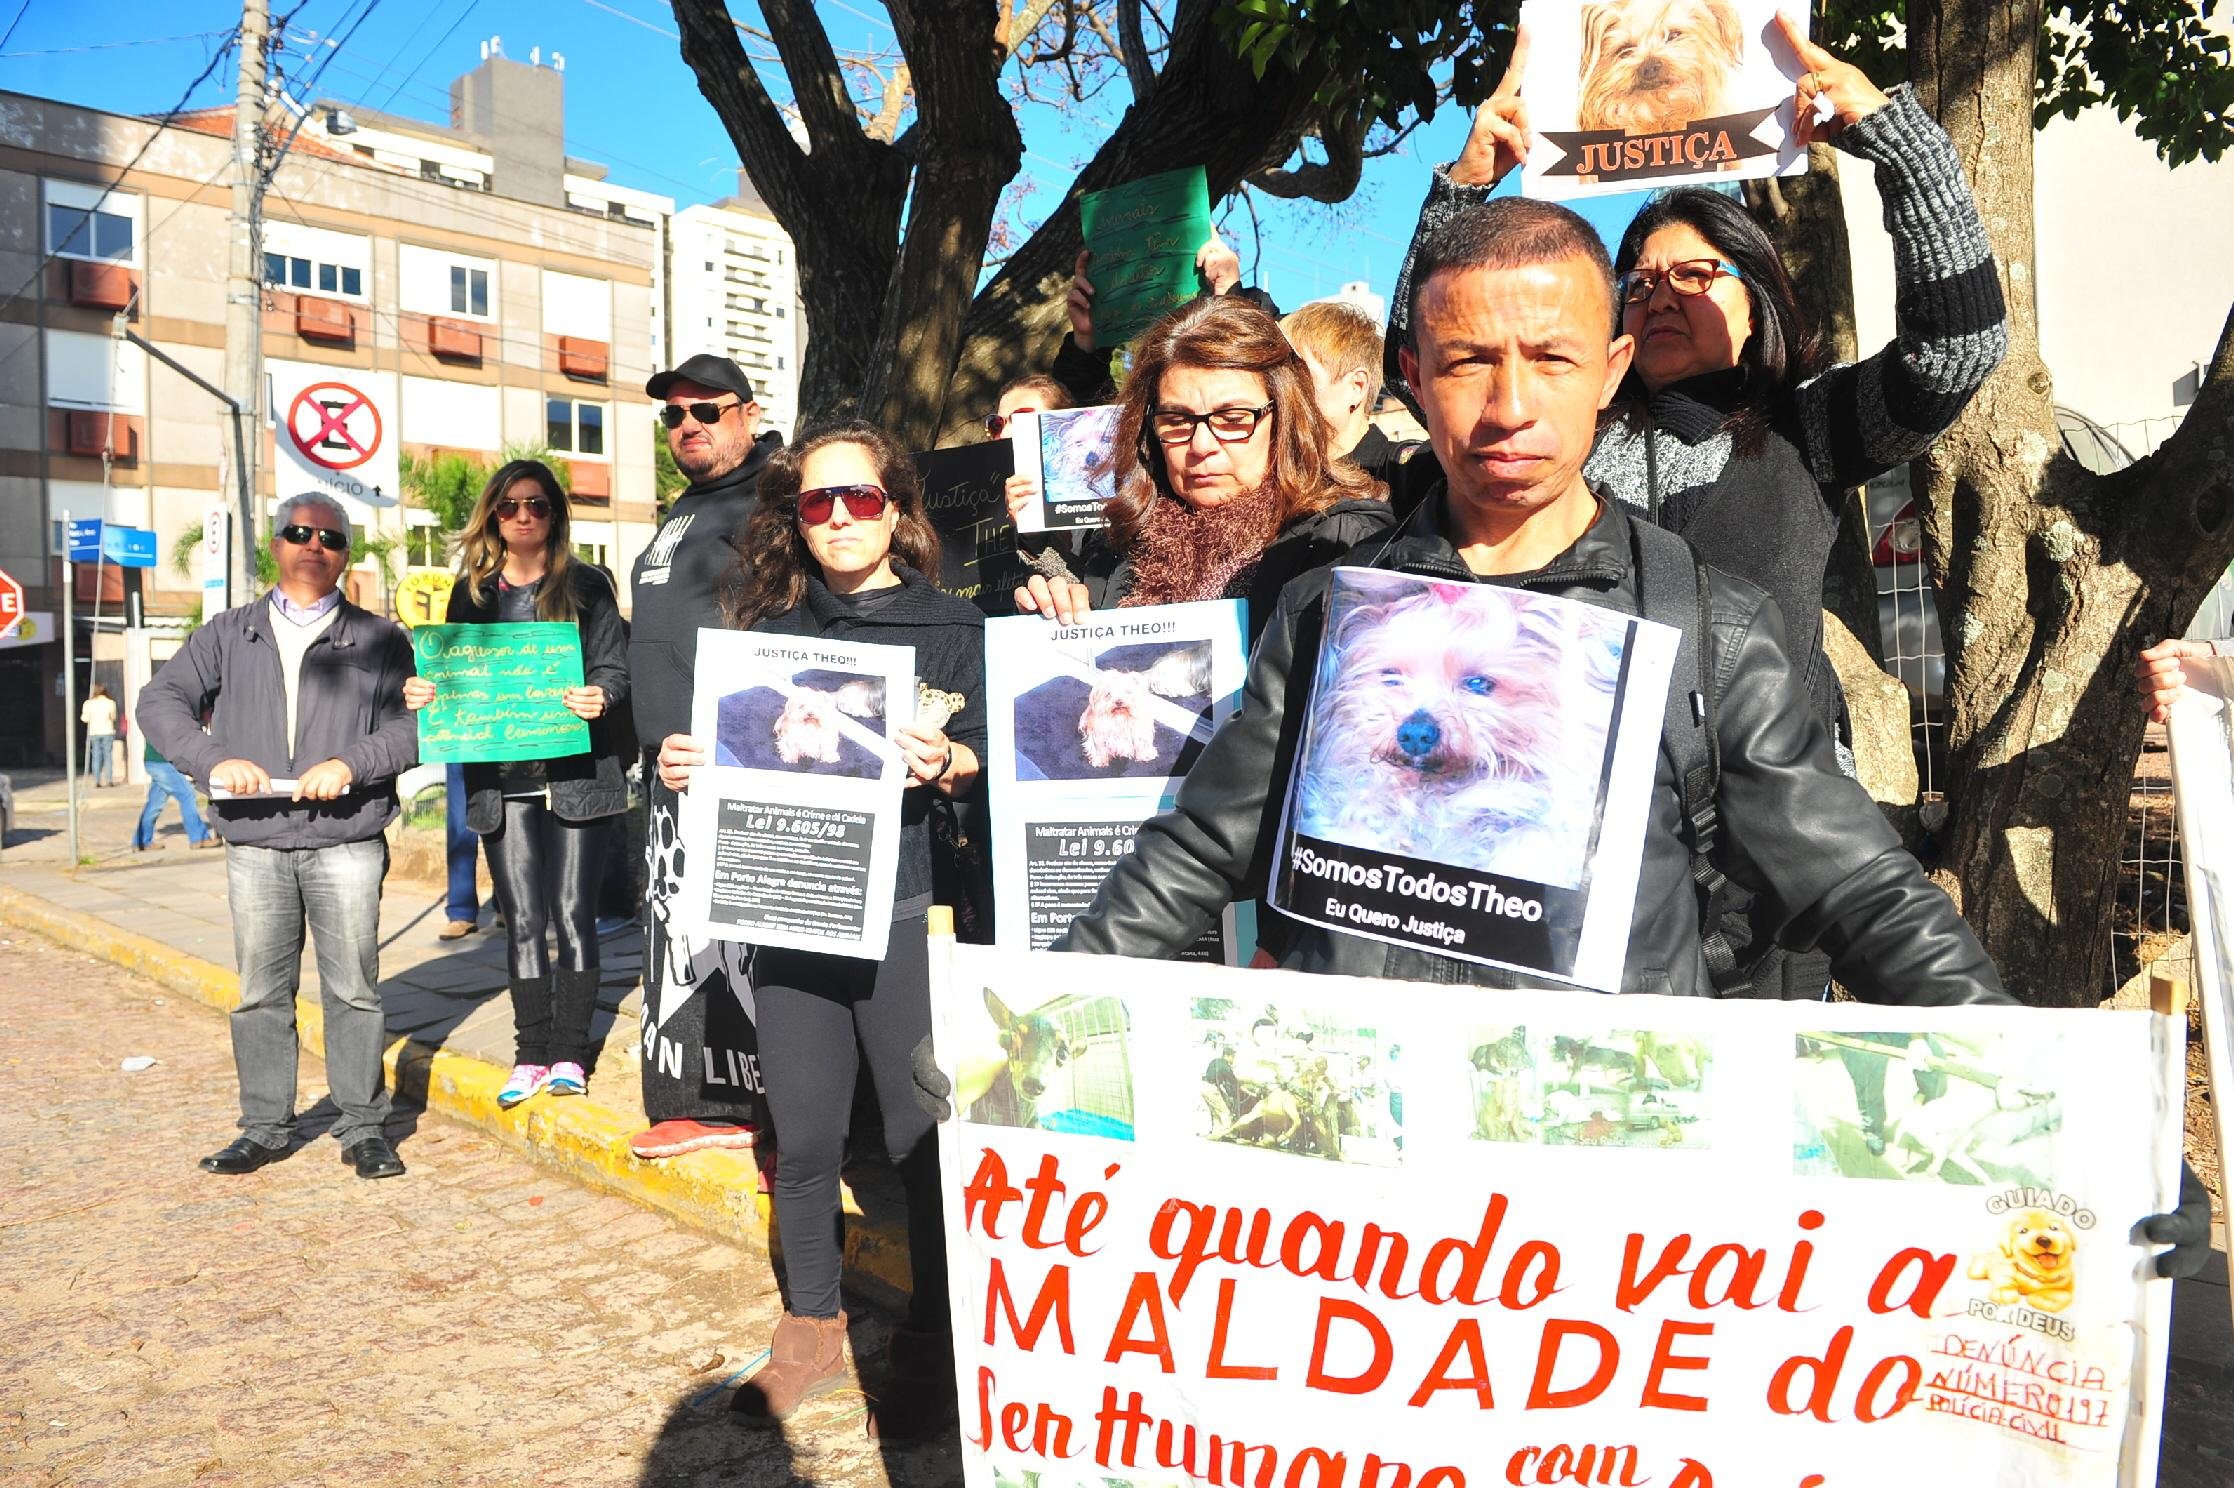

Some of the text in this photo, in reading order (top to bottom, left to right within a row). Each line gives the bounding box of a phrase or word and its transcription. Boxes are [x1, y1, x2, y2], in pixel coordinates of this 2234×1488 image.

[1576, 131, 1737, 173] JUSTIÇA
[419, 630, 443, 660] O
[1051, 621, 1176, 641] JUSTIÇA THEO!!!
[754, 647, 857, 666] JUSTIÇA THEO!!!
[727, 802, 763, 814] Maltratar
[764, 806, 796, 817] Animais
[802, 811, 826, 821] Crime
[745, 814, 846, 839] Lei 9.605/98
[1035, 826, 1076, 837] Maltratar
[1077, 826, 1114, 837] Animais
[1115, 824, 1121, 836] é
[1059, 838, 1136, 856] Lei 9.60
[715, 869, 729, 881] Em
[730, 871, 756, 883] Porto
[756, 874, 787, 888] Alegre
[787, 878, 827, 892] denuncia
[1291, 847, 1543, 922] #SomosTodosTheo
[1031, 912, 1048, 924] Em
[1325, 897, 1466, 946] Eu Quero Justiça
[1986, 1187, 2097, 1230] GUIADO
[964, 1147, 1960, 1319] Até quando vai a
[983, 1257, 1924, 1423] MALDADE do
[2016, 1308, 2075, 1342] DEUS
[1930, 1363, 2110, 1426] NÚMERO 197
[966, 1365, 1087, 1459] Ser
[1505, 1443, 1652, 1488] com
